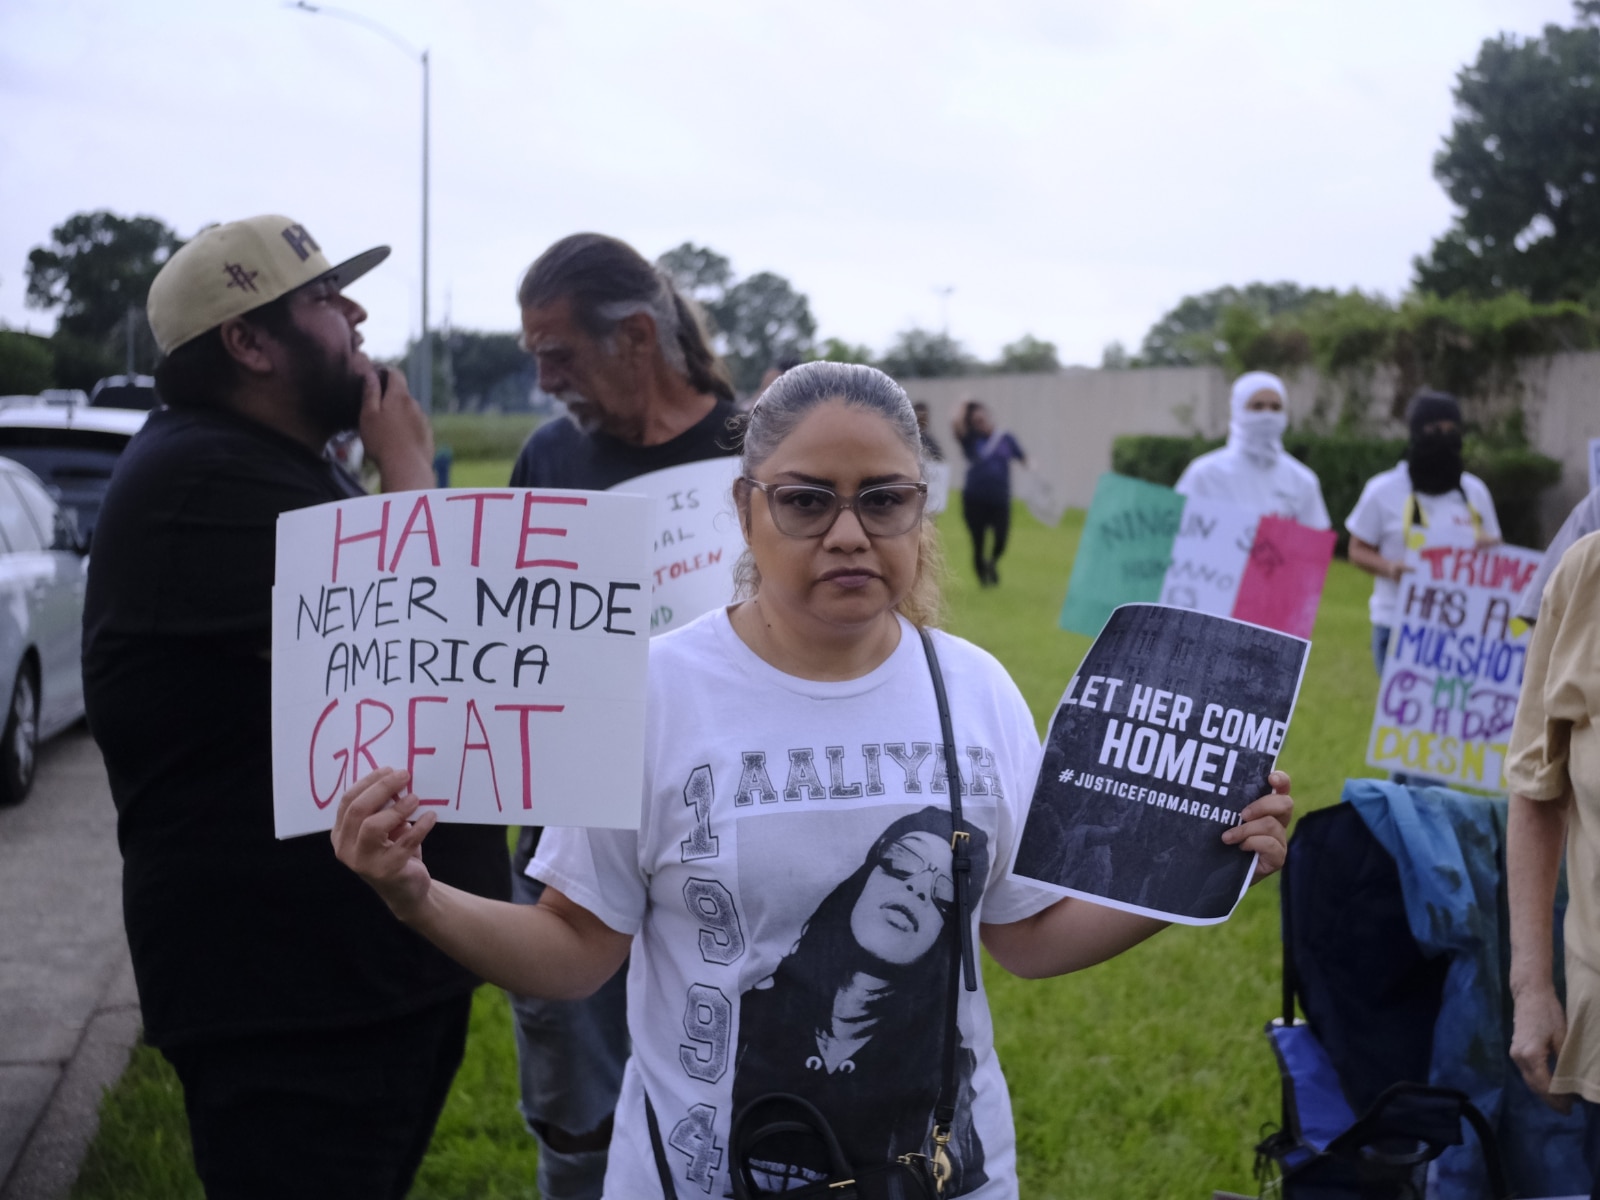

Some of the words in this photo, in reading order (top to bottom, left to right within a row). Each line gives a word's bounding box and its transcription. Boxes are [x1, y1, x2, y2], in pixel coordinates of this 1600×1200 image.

[667, 488, 700, 512] IS
[332, 491, 587, 583] HATE
[652, 547, 722, 594] TOLEN
[297, 577, 447, 640] NEVER
[476, 577, 641, 636] MADE
[1404, 585, 1466, 628] HAS
[1481, 597, 1511, 640] A
[325, 638, 550, 696] AMERICA
[1395, 623, 1527, 687] MUGSHOT
[1061, 675, 1123, 712] LET
[1127, 683, 1193, 732] HER
[1200, 703, 1287, 756] COME
[1432, 675, 1474, 712] MY
[309, 696, 565, 812] GREAT
[1099, 718, 1238, 797] HOME!
